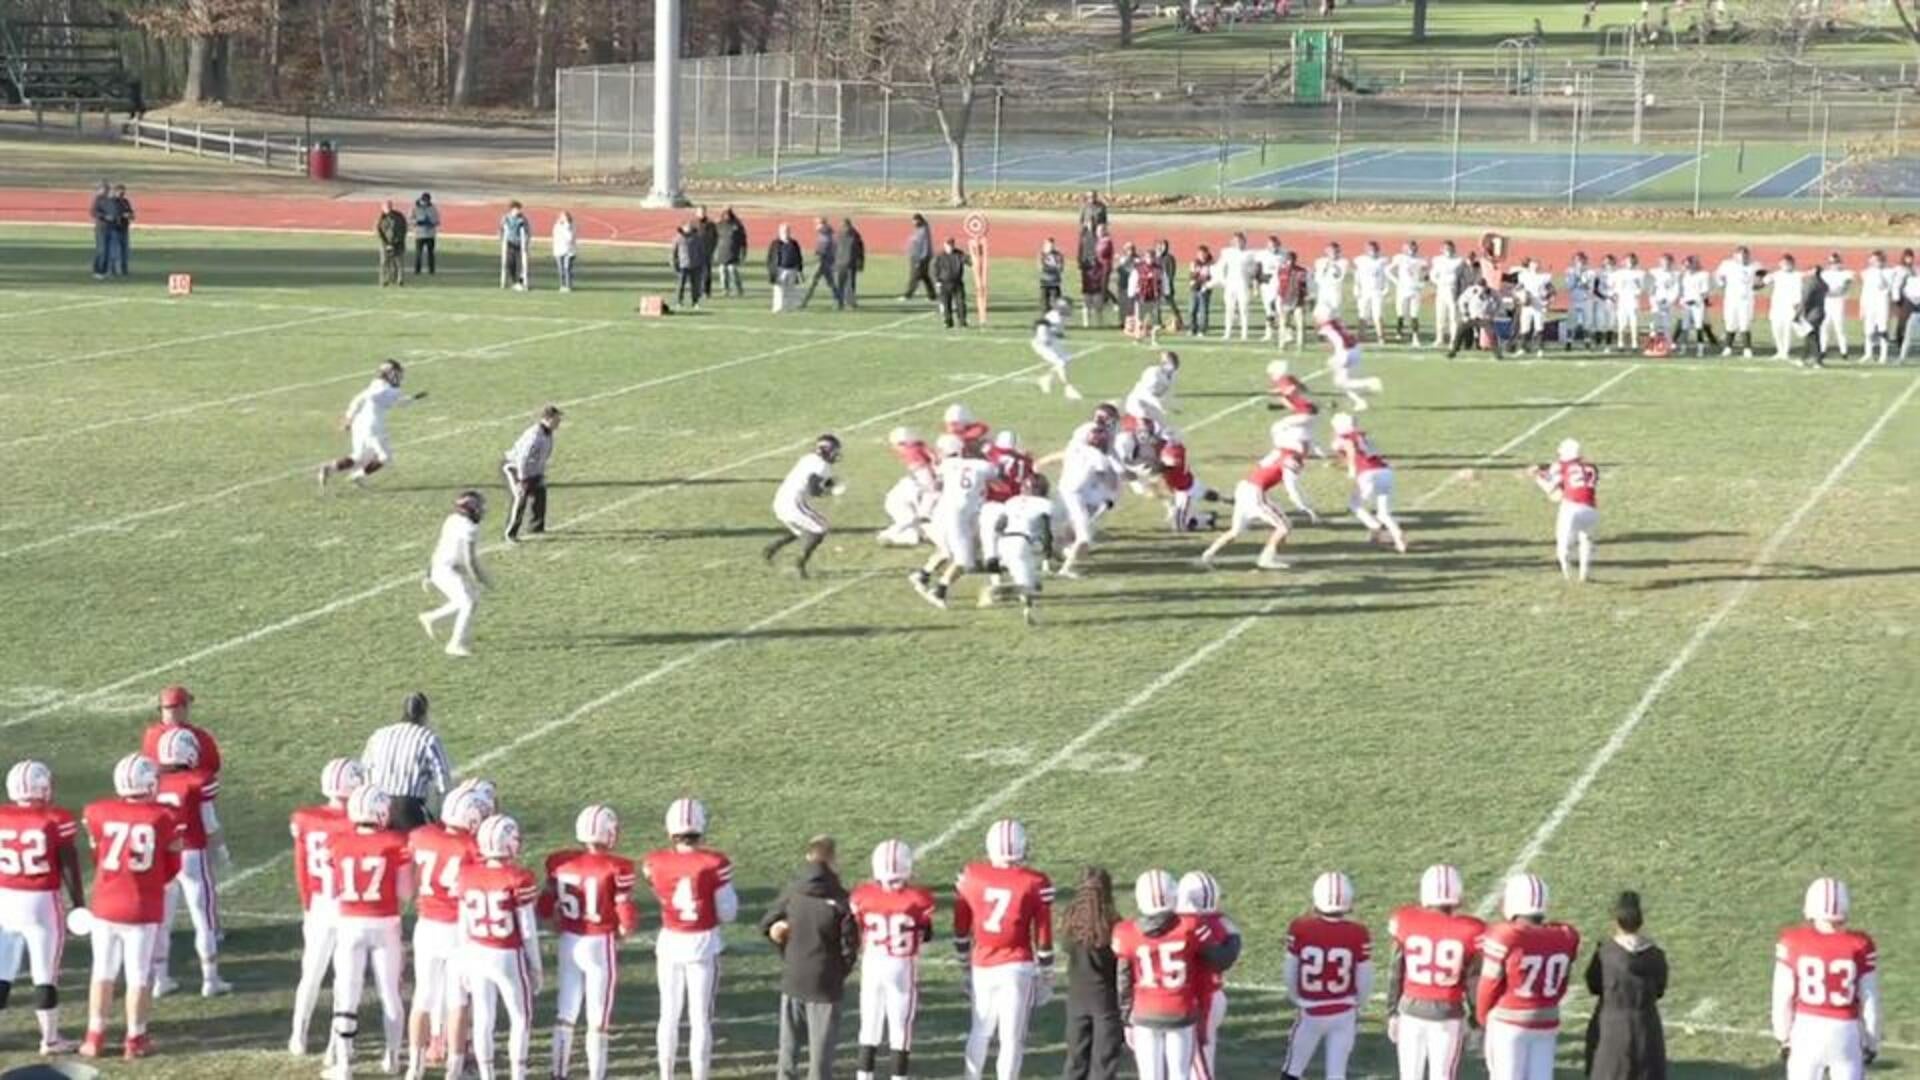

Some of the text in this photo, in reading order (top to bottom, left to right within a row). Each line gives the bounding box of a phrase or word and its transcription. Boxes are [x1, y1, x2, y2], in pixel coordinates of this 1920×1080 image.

[0, 829, 50, 875] 52
[102, 821, 156, 872] 79
[340, 856, 387, 901] 17
[415, 850, 462, 897] 74
[463, 889, 515, 938] 25
[557, 873, 601, 923] 51
[671, 877, 699, 921] 4
[983, 887, 1012, 933] 7
[863, 912, 916, 952] 26
[1136, 940, 1187, 989] 15
[1300, 945, 1353, 993] 23
[1404, 935, 1465, 987] 29
[1514, 953, 1570, 998] 70
[1796, 955, 1857, 1007] 83
